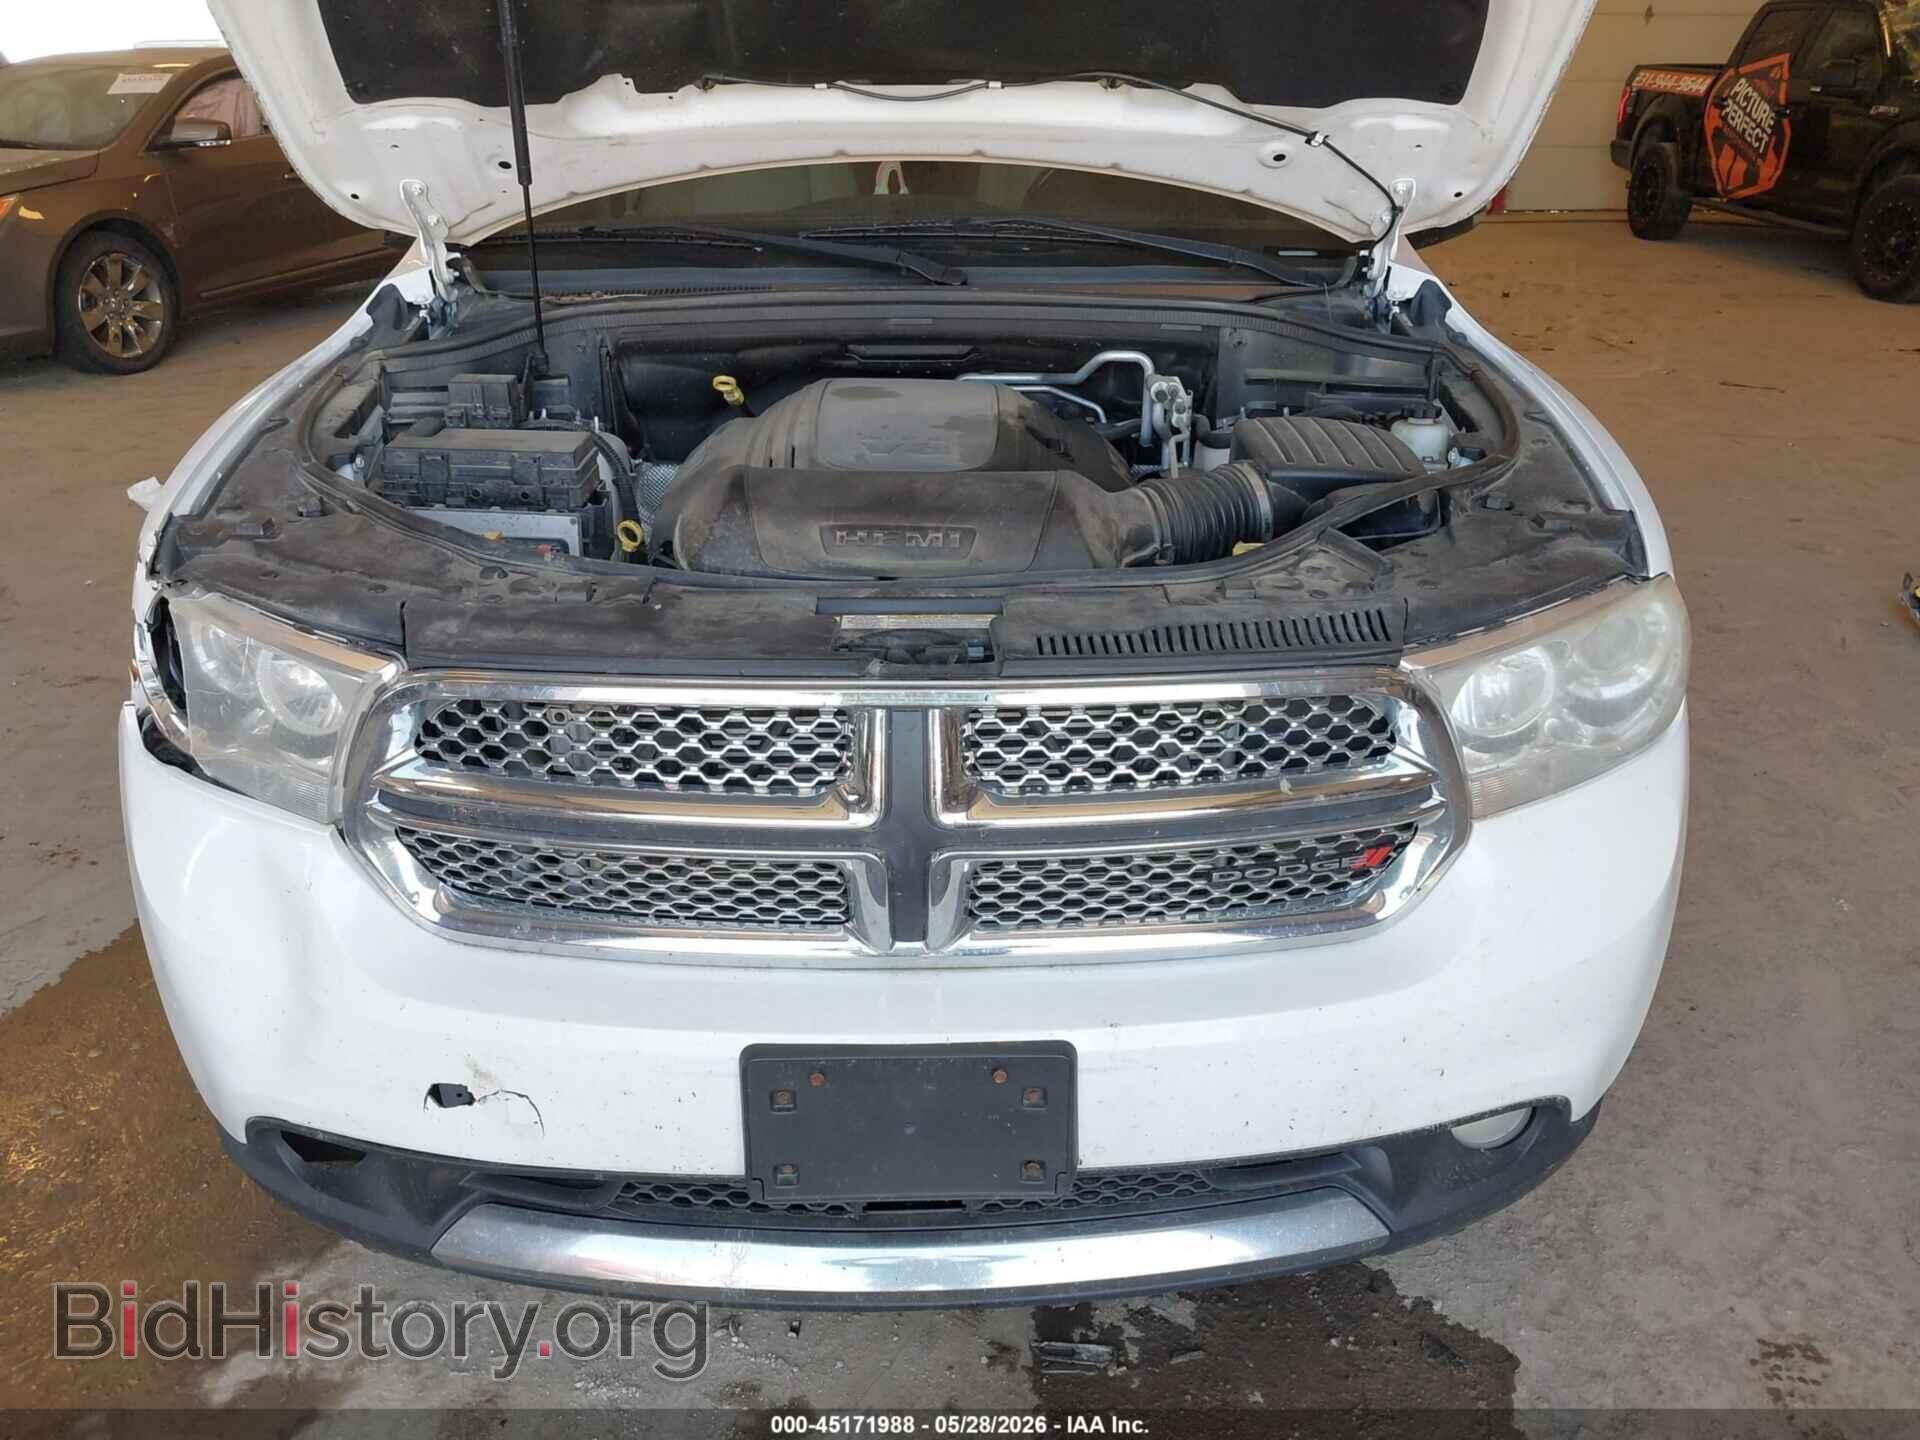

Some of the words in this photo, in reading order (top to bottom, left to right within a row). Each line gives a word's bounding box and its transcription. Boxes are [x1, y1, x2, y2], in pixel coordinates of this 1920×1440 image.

[1721, 98, 1769, 153] PERFECT
[1730, 78, 1776, 135] PICTURE
[833, 529, 961, 548] HEMI
[1211, 856, 1370, 883] DODGE
